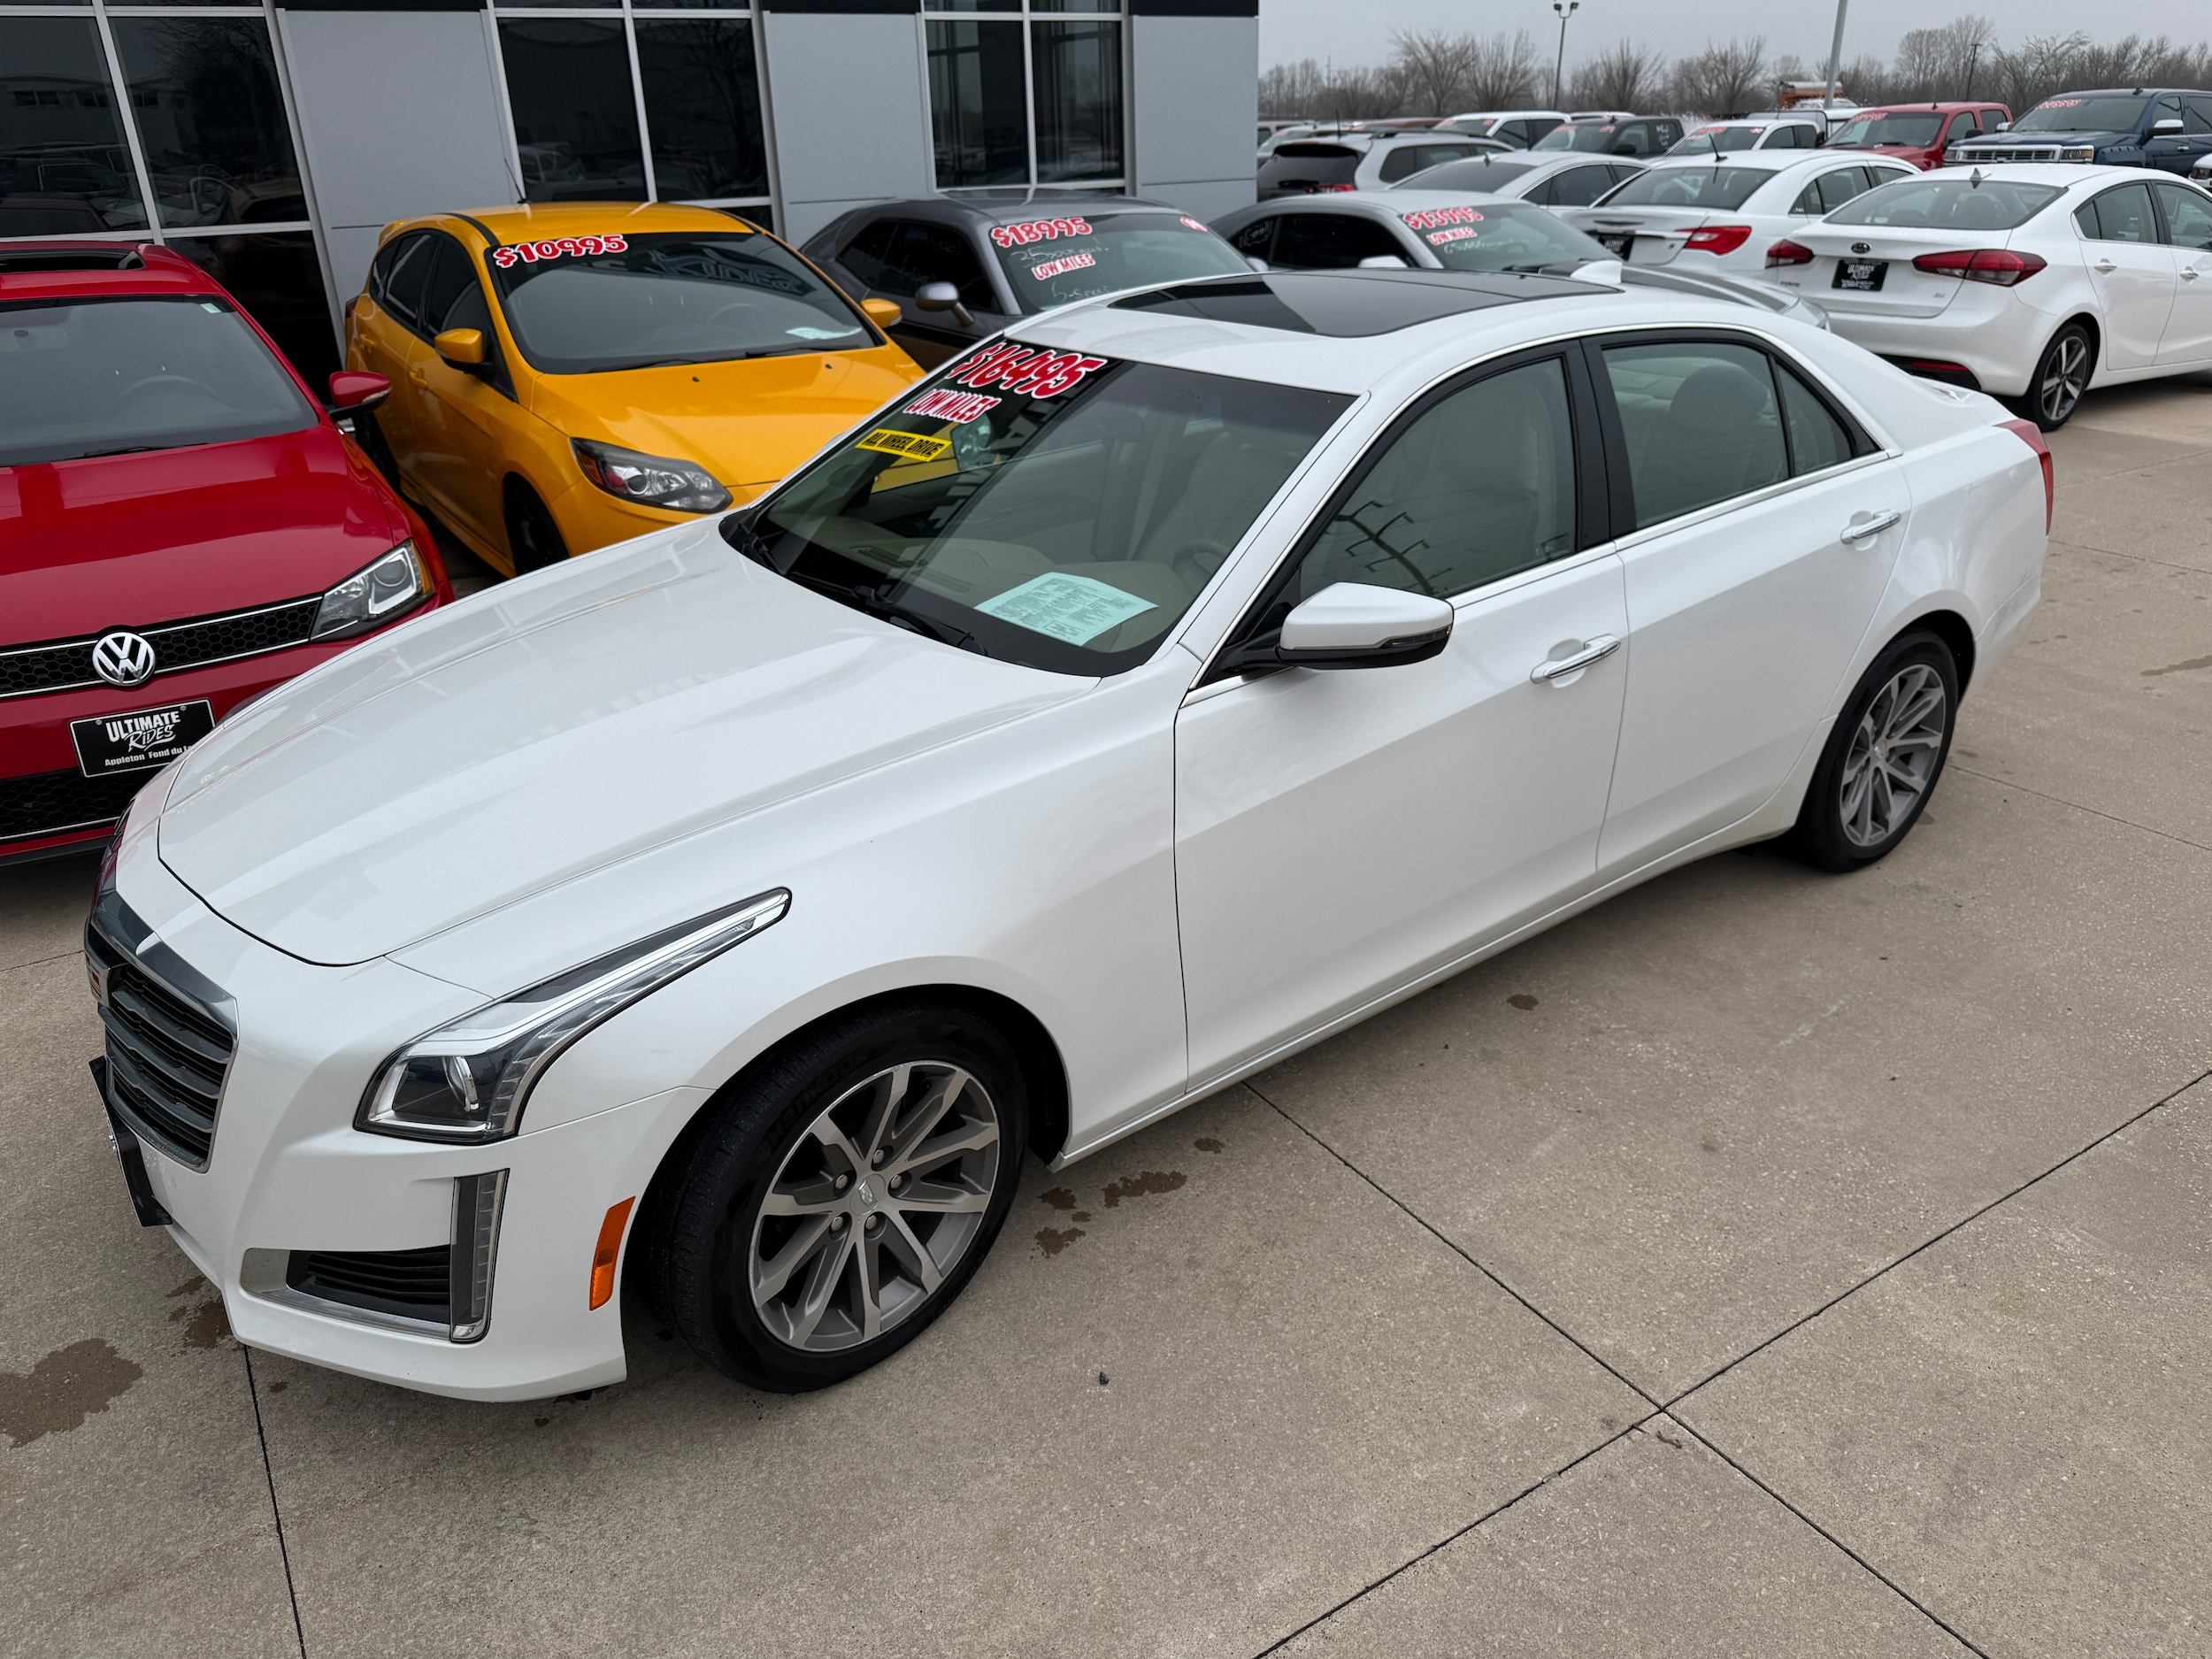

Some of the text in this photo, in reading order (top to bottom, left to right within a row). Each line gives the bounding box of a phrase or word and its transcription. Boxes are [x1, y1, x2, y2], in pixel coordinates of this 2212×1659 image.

[991, 217, 1094, 248] $18995
[493, 234, 628, 268] $10995
[1031, 253, 1096, 280] LOW MILES
[945, 341, 1108, 398] $16495
[902, 388, 1002, 424] LOW MILES
[861, 432, 945, 458] ALL WHEEL DRIVE
[105, 710, 181, 743] ULTIMATE
[104, 753, 145, 767] Appleton
[148, 748, 171, 759] Fond
[171, 747, 183, 756] du
